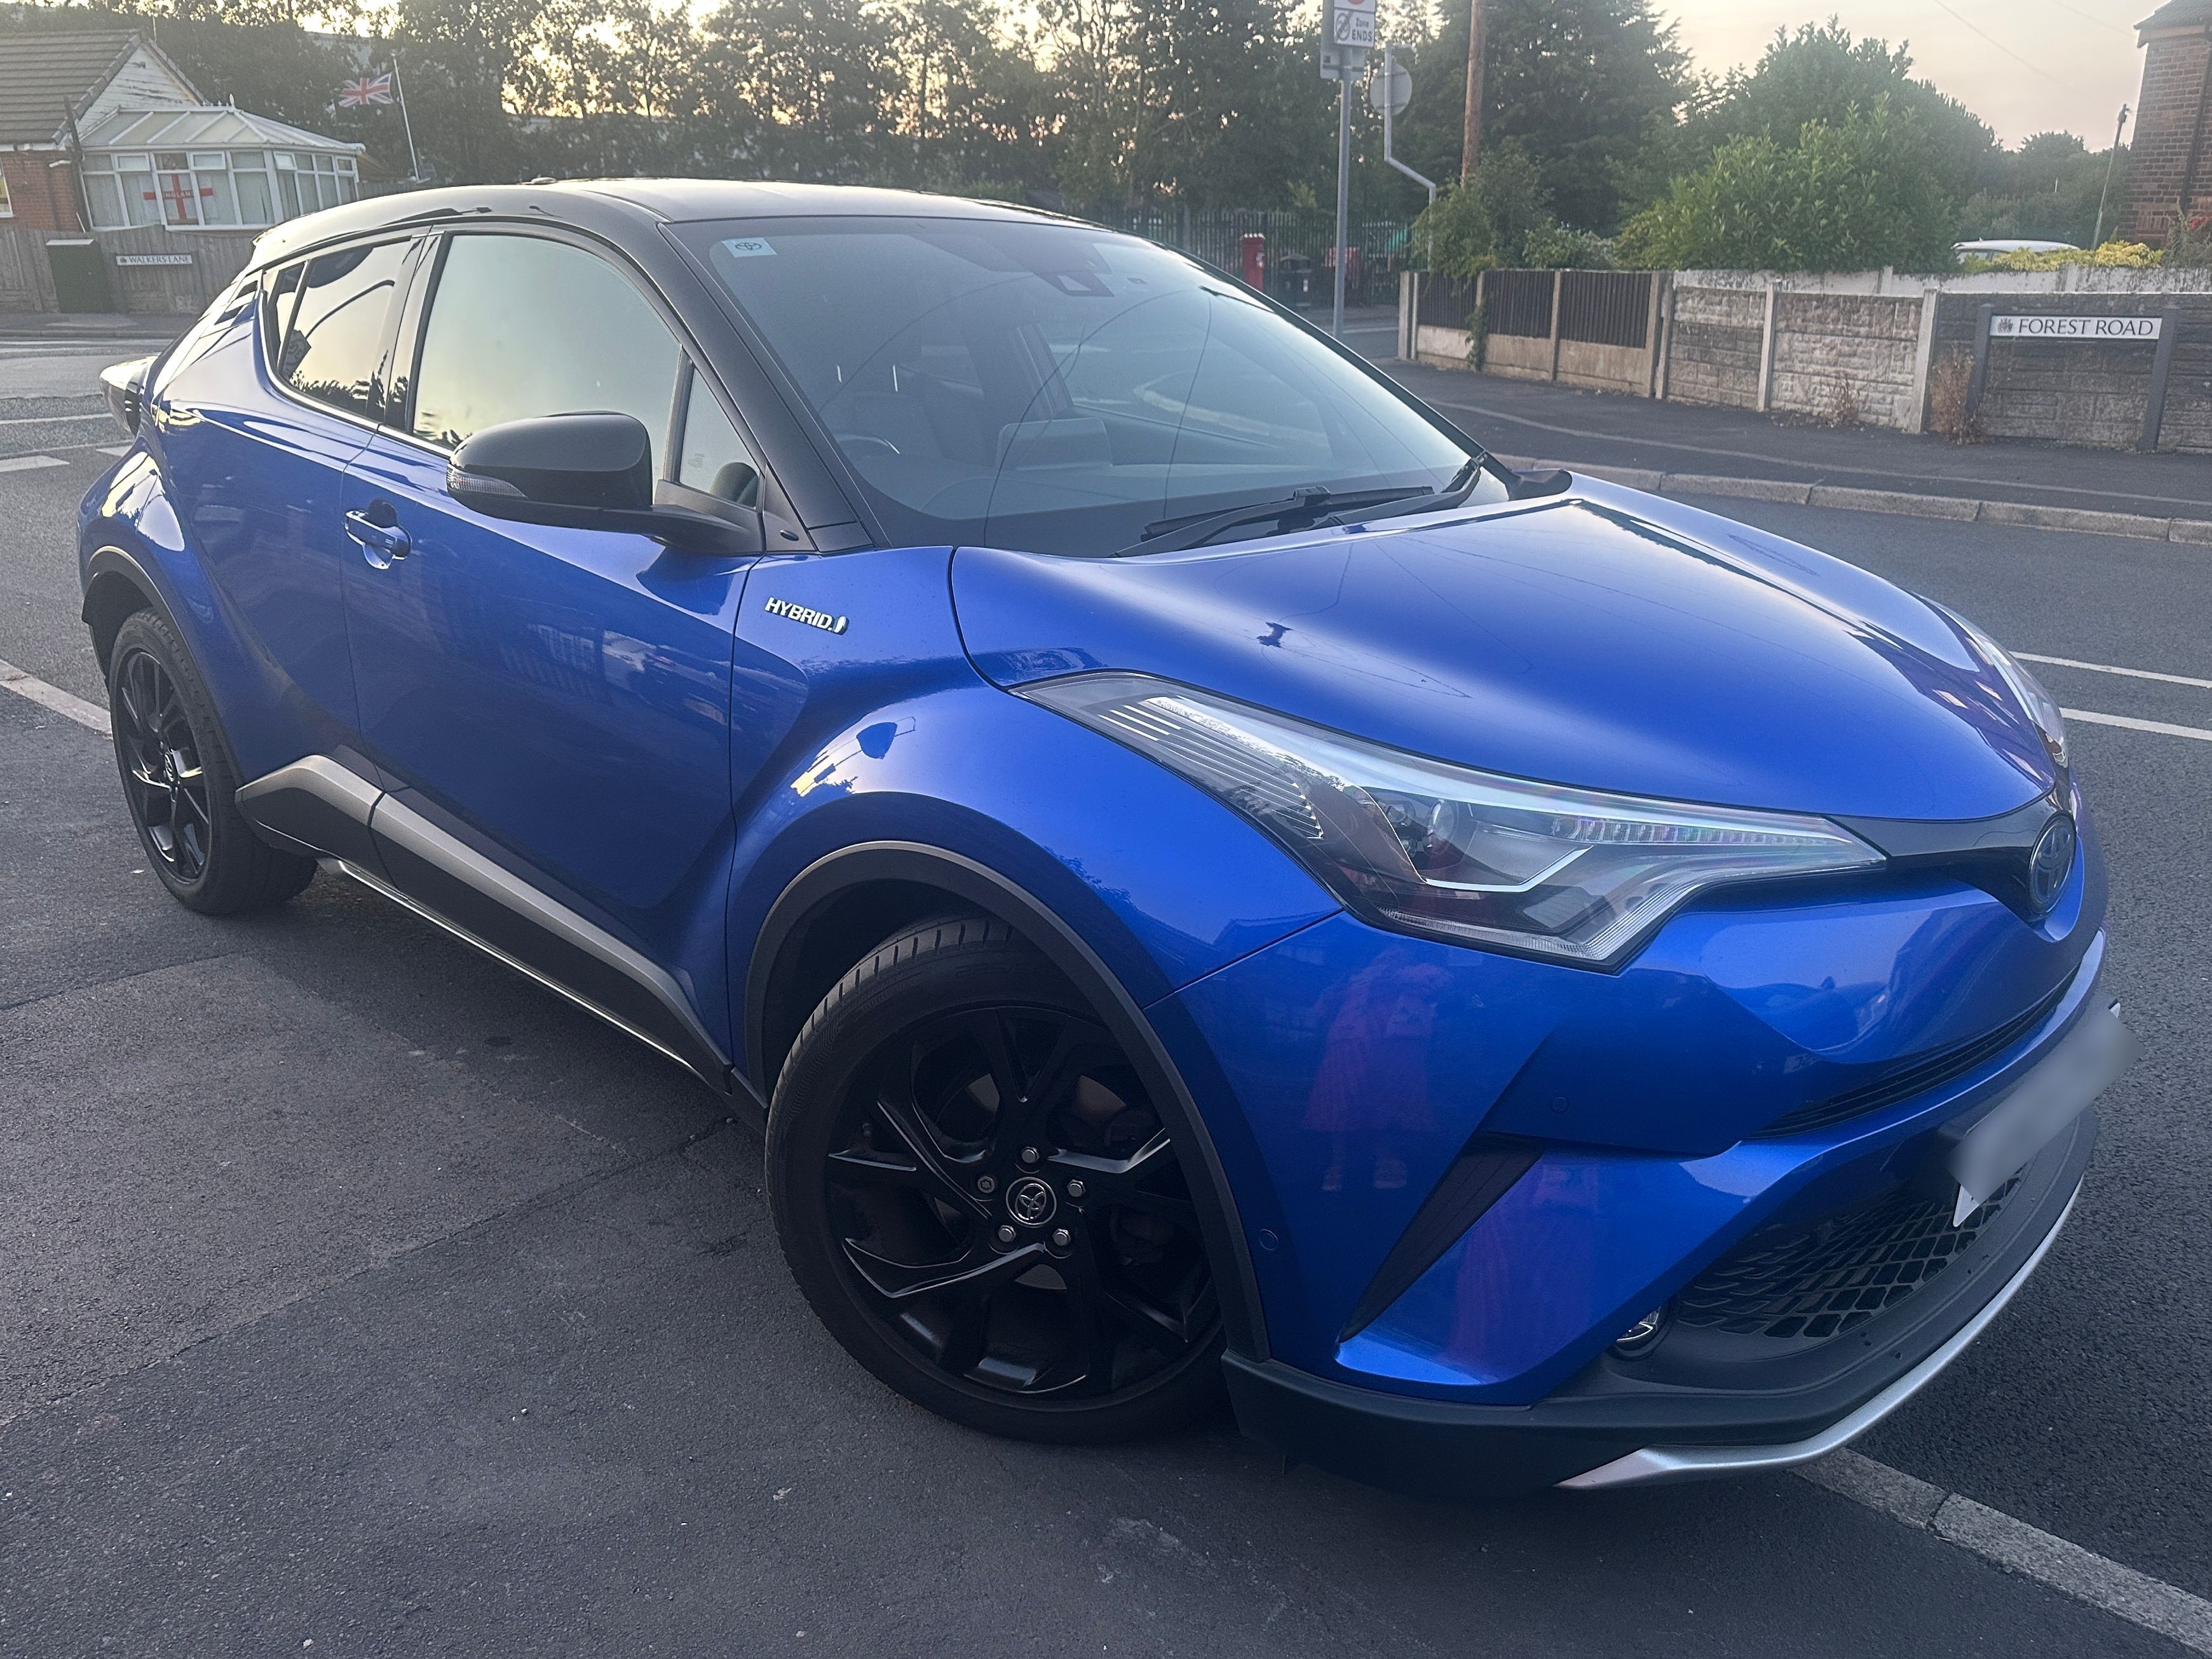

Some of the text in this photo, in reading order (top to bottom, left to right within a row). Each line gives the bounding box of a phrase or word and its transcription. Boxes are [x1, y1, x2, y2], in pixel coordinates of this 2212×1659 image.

[1355, 18, 1369, 28] Zone
[1352, 29, 1372, 41] ENDS
[2018, 318, 2153, 335] FOREST ROAD
